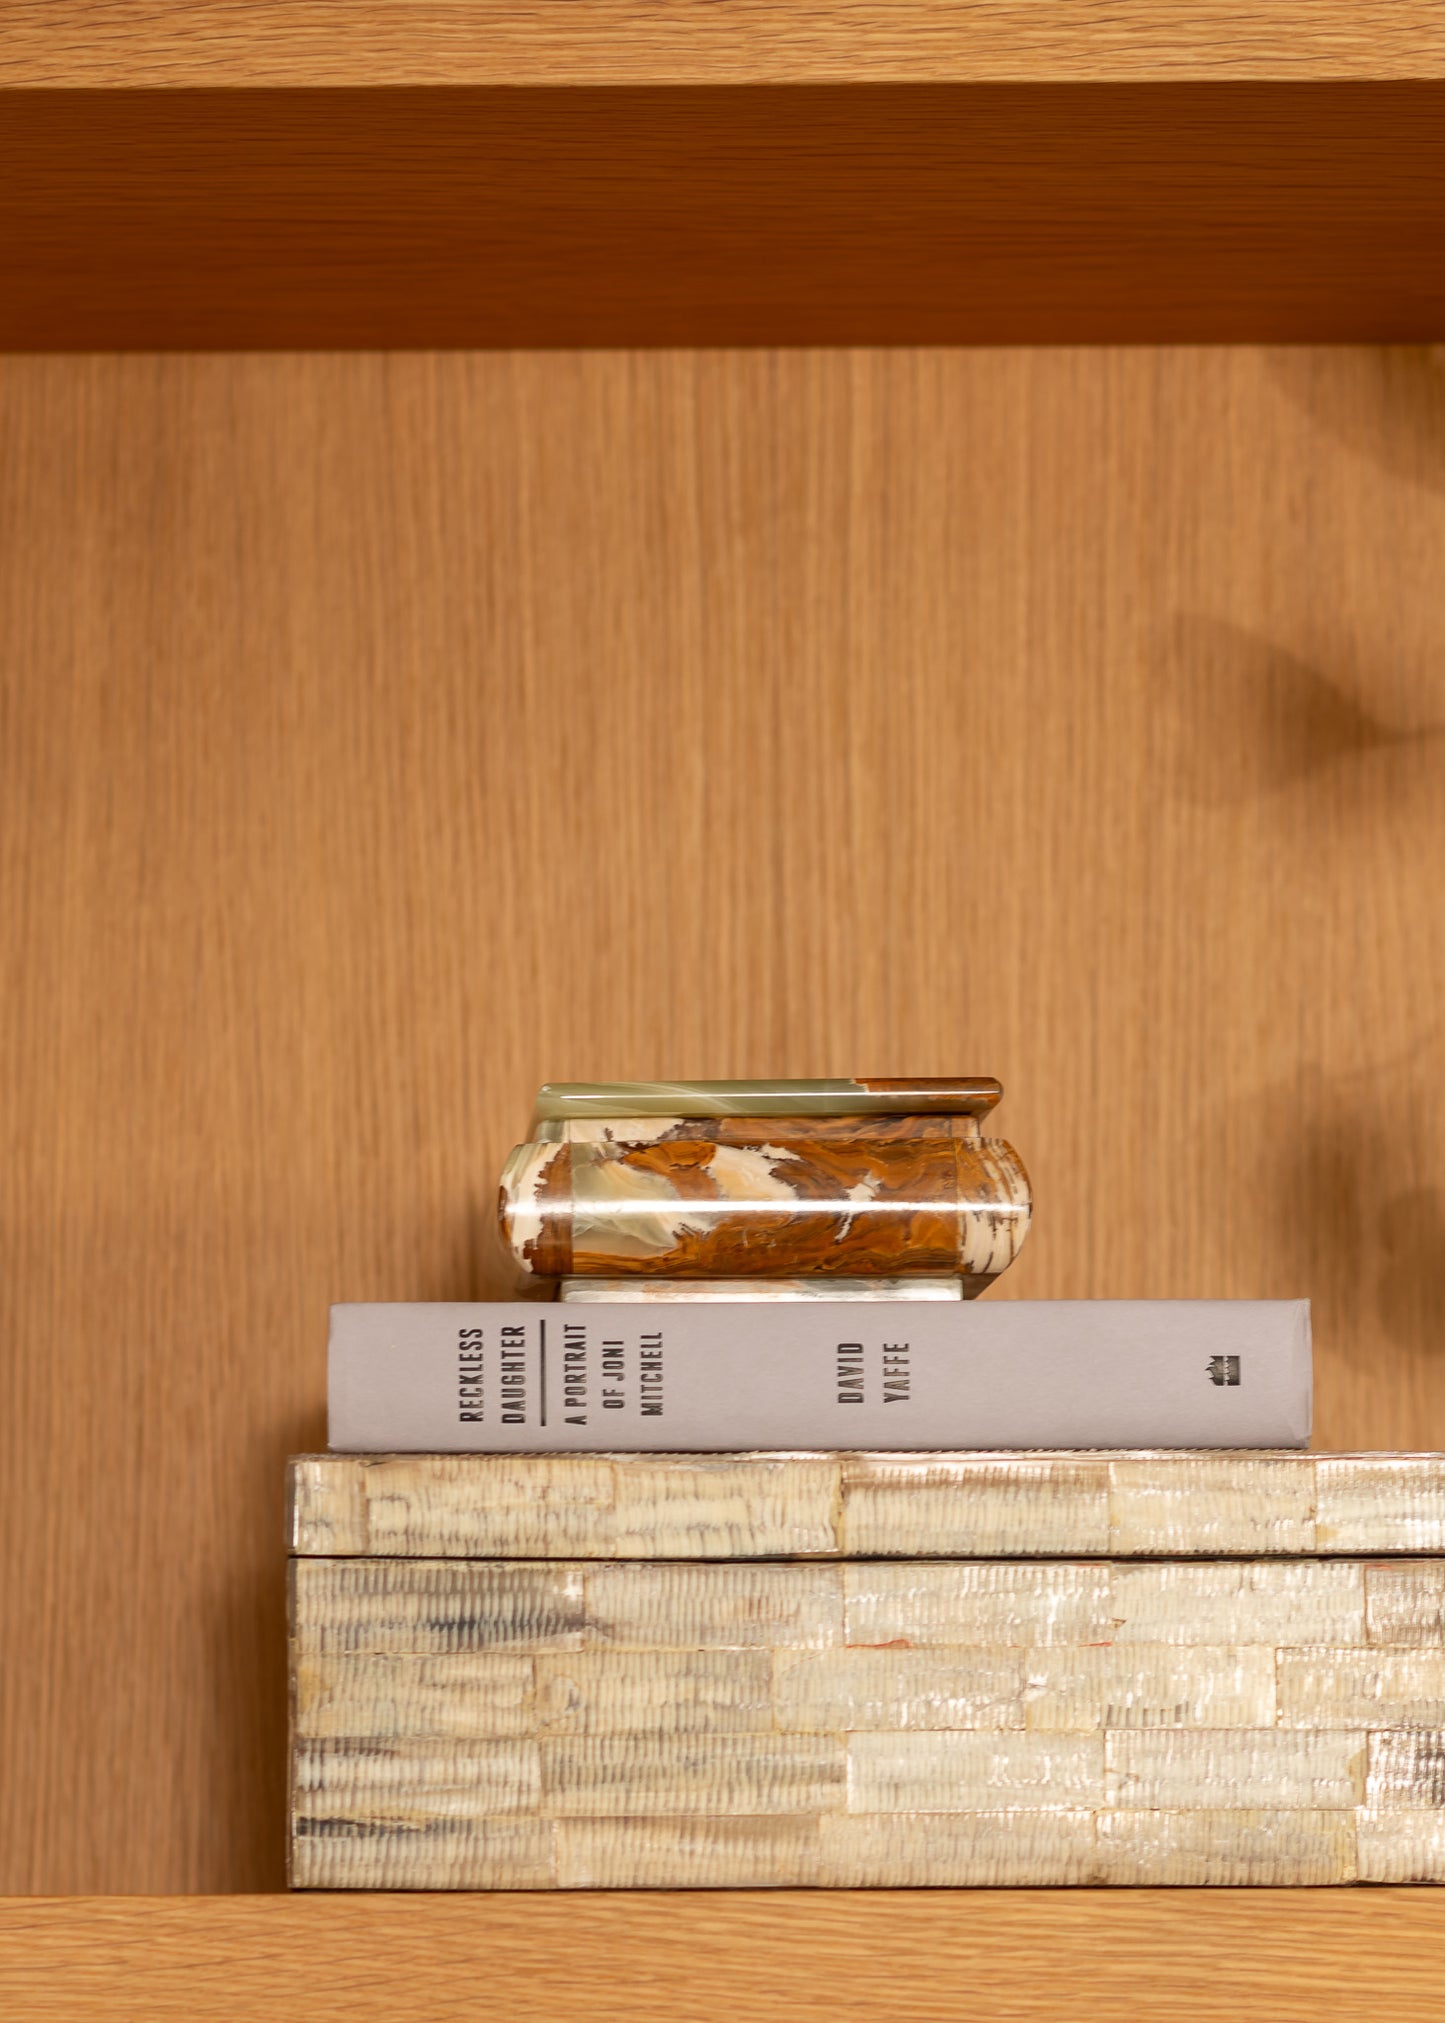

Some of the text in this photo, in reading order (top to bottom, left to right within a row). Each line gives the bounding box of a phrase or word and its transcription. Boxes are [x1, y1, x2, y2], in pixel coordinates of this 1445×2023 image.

[459, 1328, 484, 1422] RECKLESS
[501, 1326, 526, 1424] DAUGHTER
[564, 1324, 587, 1426] A PORTRAIT
[602, 1340, 625, 1409] OF JONI
[640, 1332, 663, 1416] MITCHELL
[837, 1343, 864, 1404] DAVID
[883, 1343, 910, 1404] YAFFE
